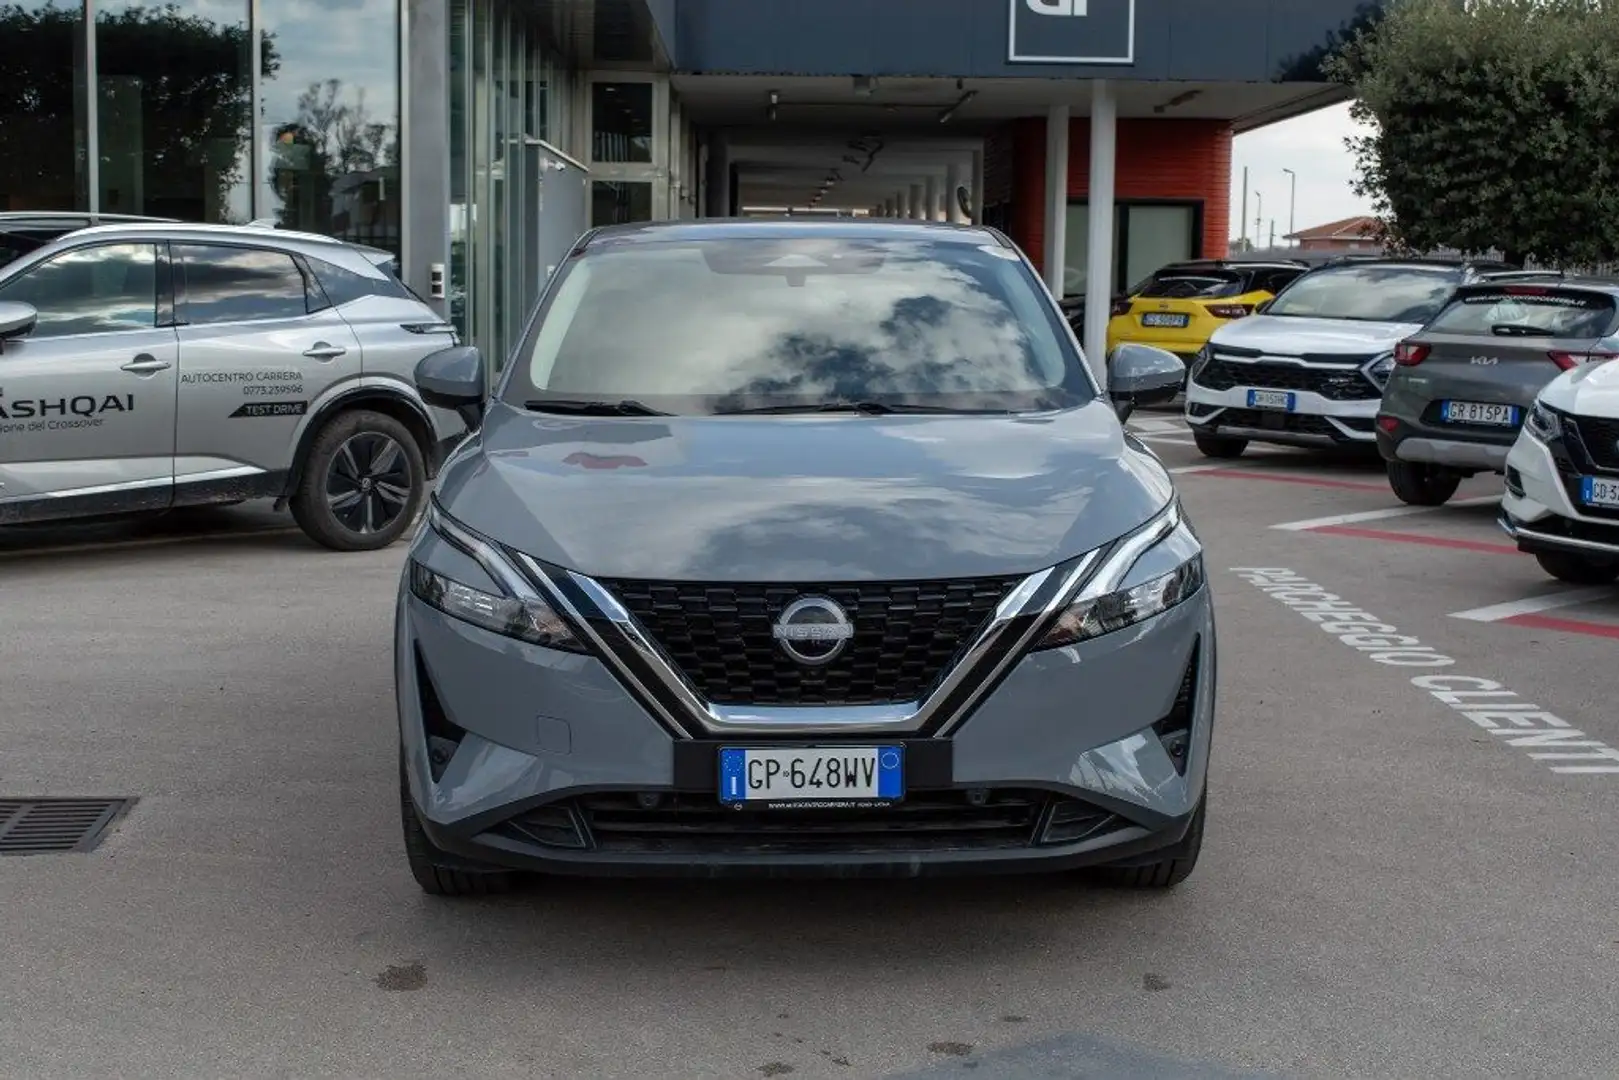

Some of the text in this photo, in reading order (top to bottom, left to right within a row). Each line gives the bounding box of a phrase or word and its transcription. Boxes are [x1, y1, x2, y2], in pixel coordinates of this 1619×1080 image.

[180, 371, 303, 383] AUTOCENTRO CARRERA
[246, 403, 302, 416] TEST DRIVE
[48, 418, 103, 430] Crossover
[1229, 567, 1456, 667] PARCHEGGIO
[774, 626, 852, 638] NISSAN
